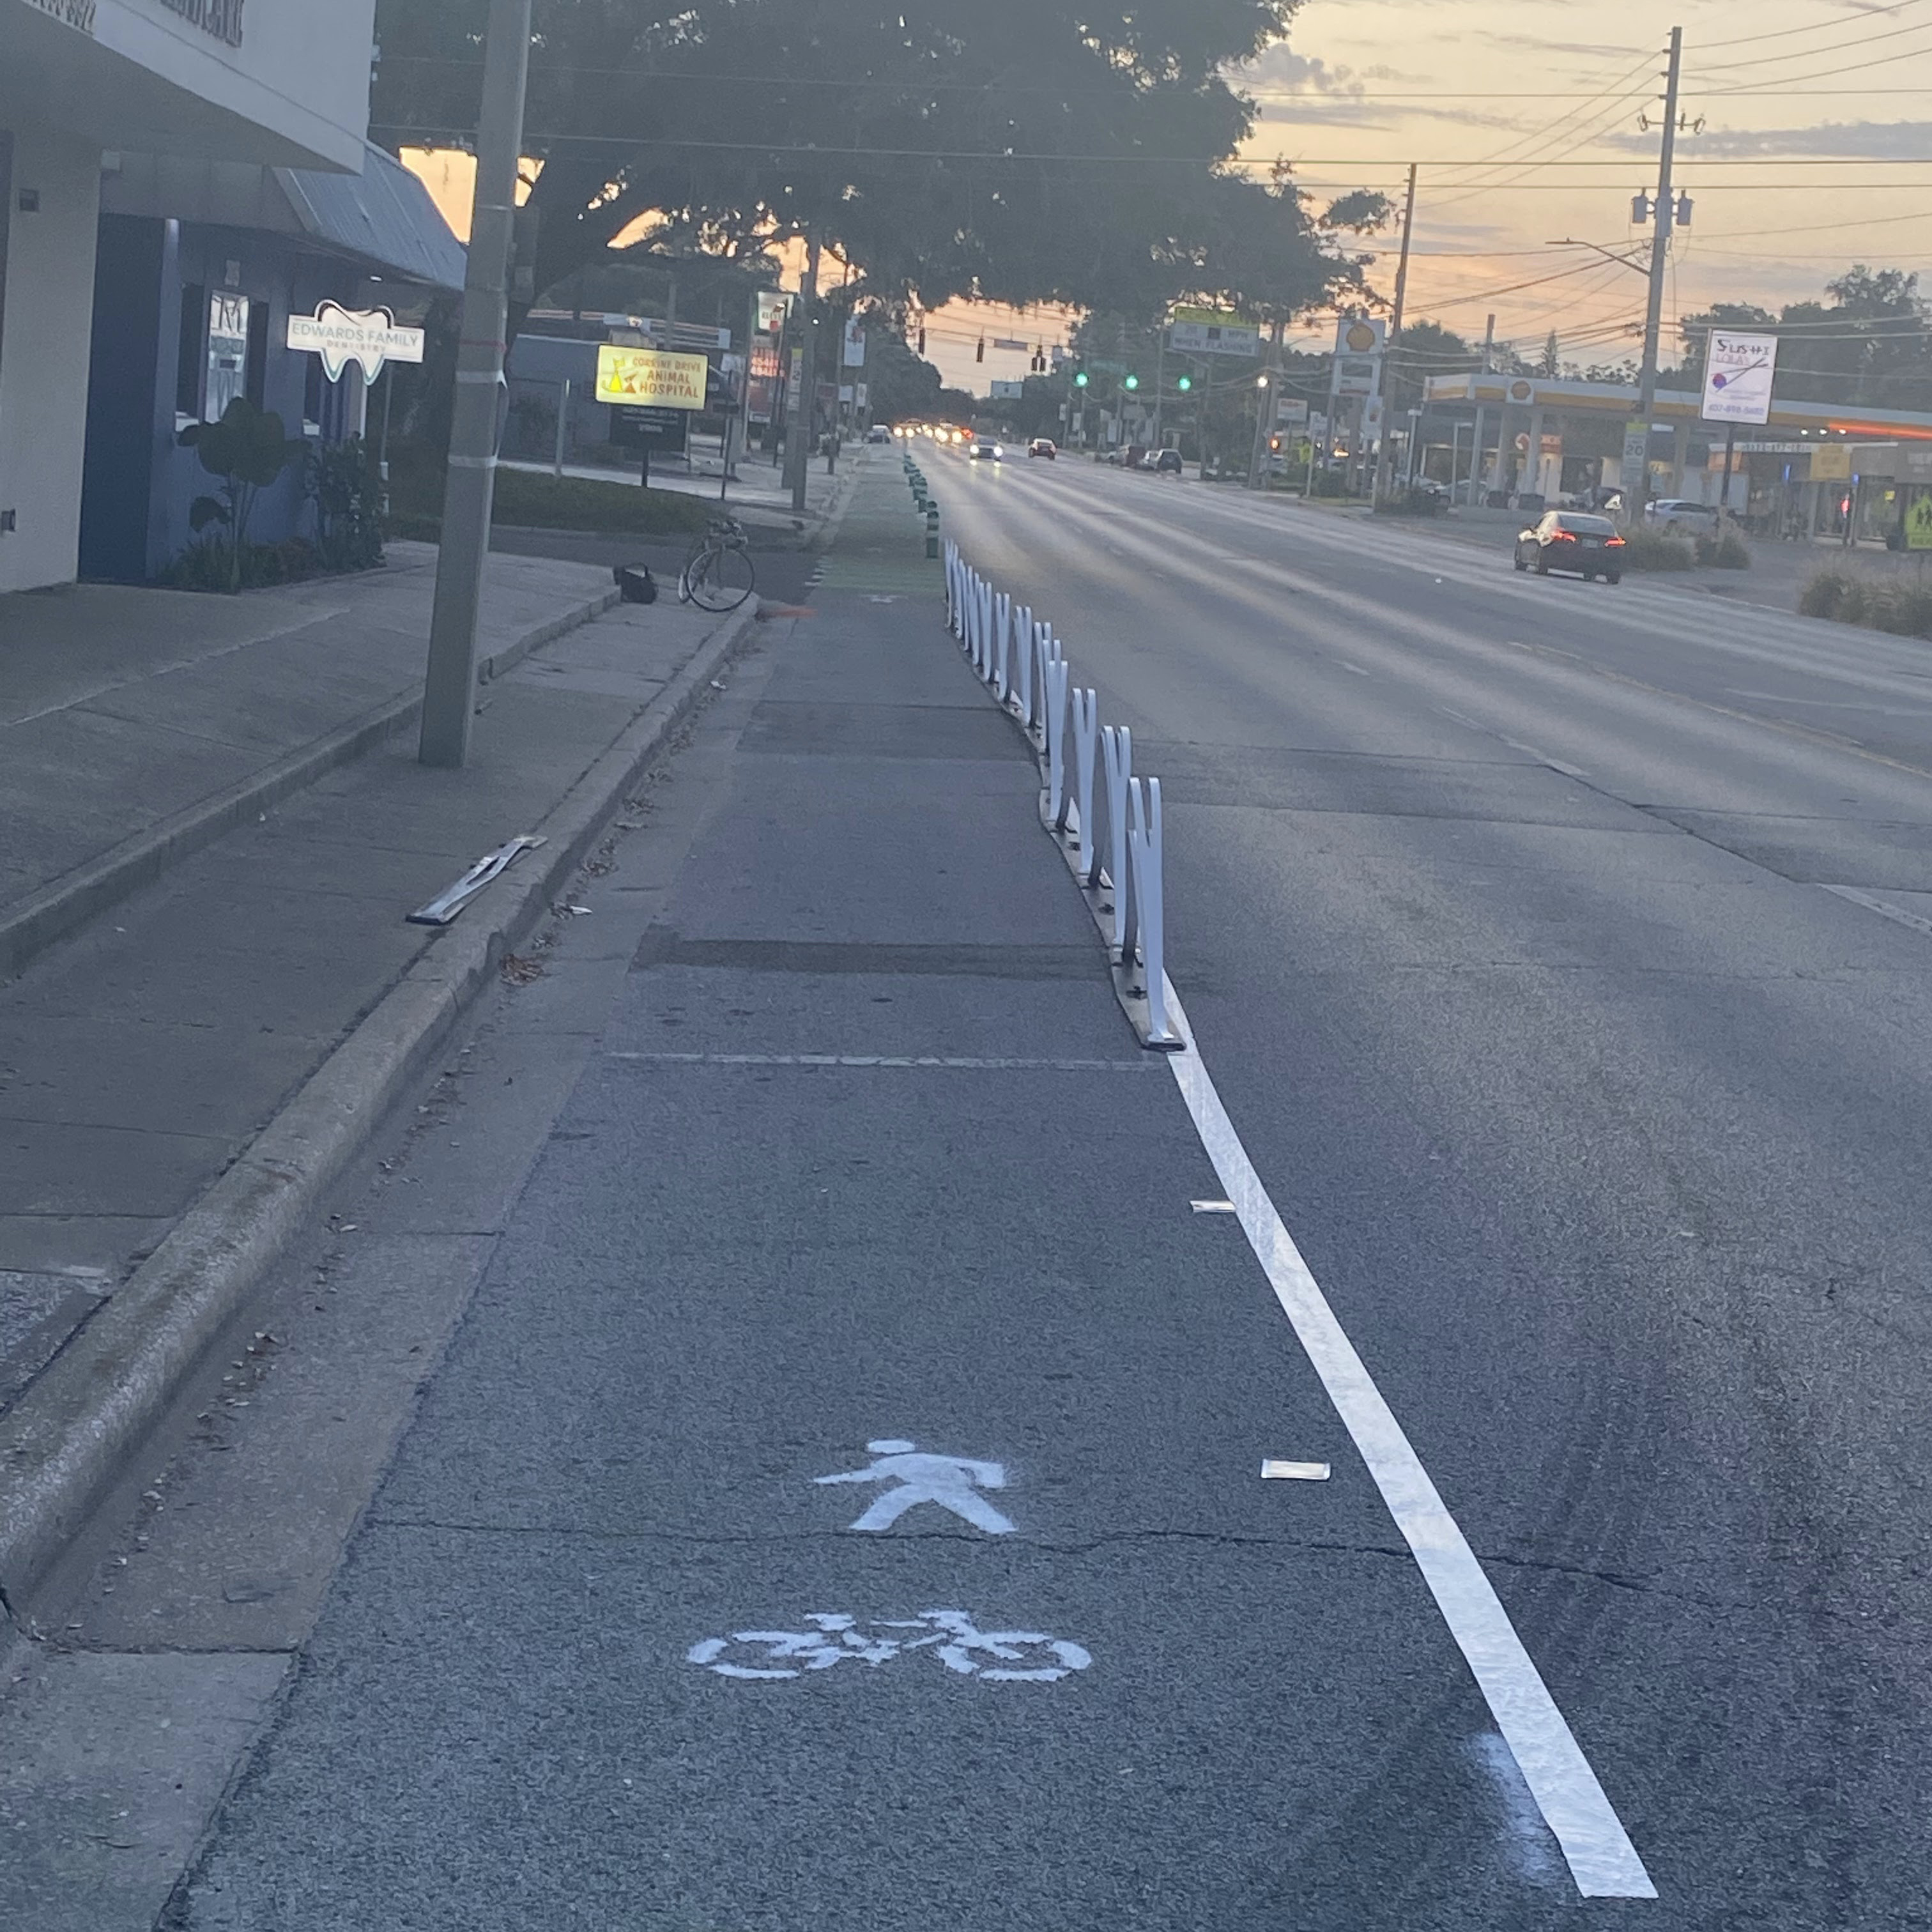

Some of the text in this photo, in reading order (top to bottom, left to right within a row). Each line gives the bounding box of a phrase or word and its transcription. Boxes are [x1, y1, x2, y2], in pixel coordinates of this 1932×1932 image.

[292, 322, 418, 348] EDWARDS FAMILY
[326, 339, 387, 352] DENTISTRY
[675, 360, 701, 372] DRIVE
[647, 369, 691, 384] ANIMAL
[640, 379, 698, 398] HOSPITAL
[1625, 445, 1643, 456] 20
